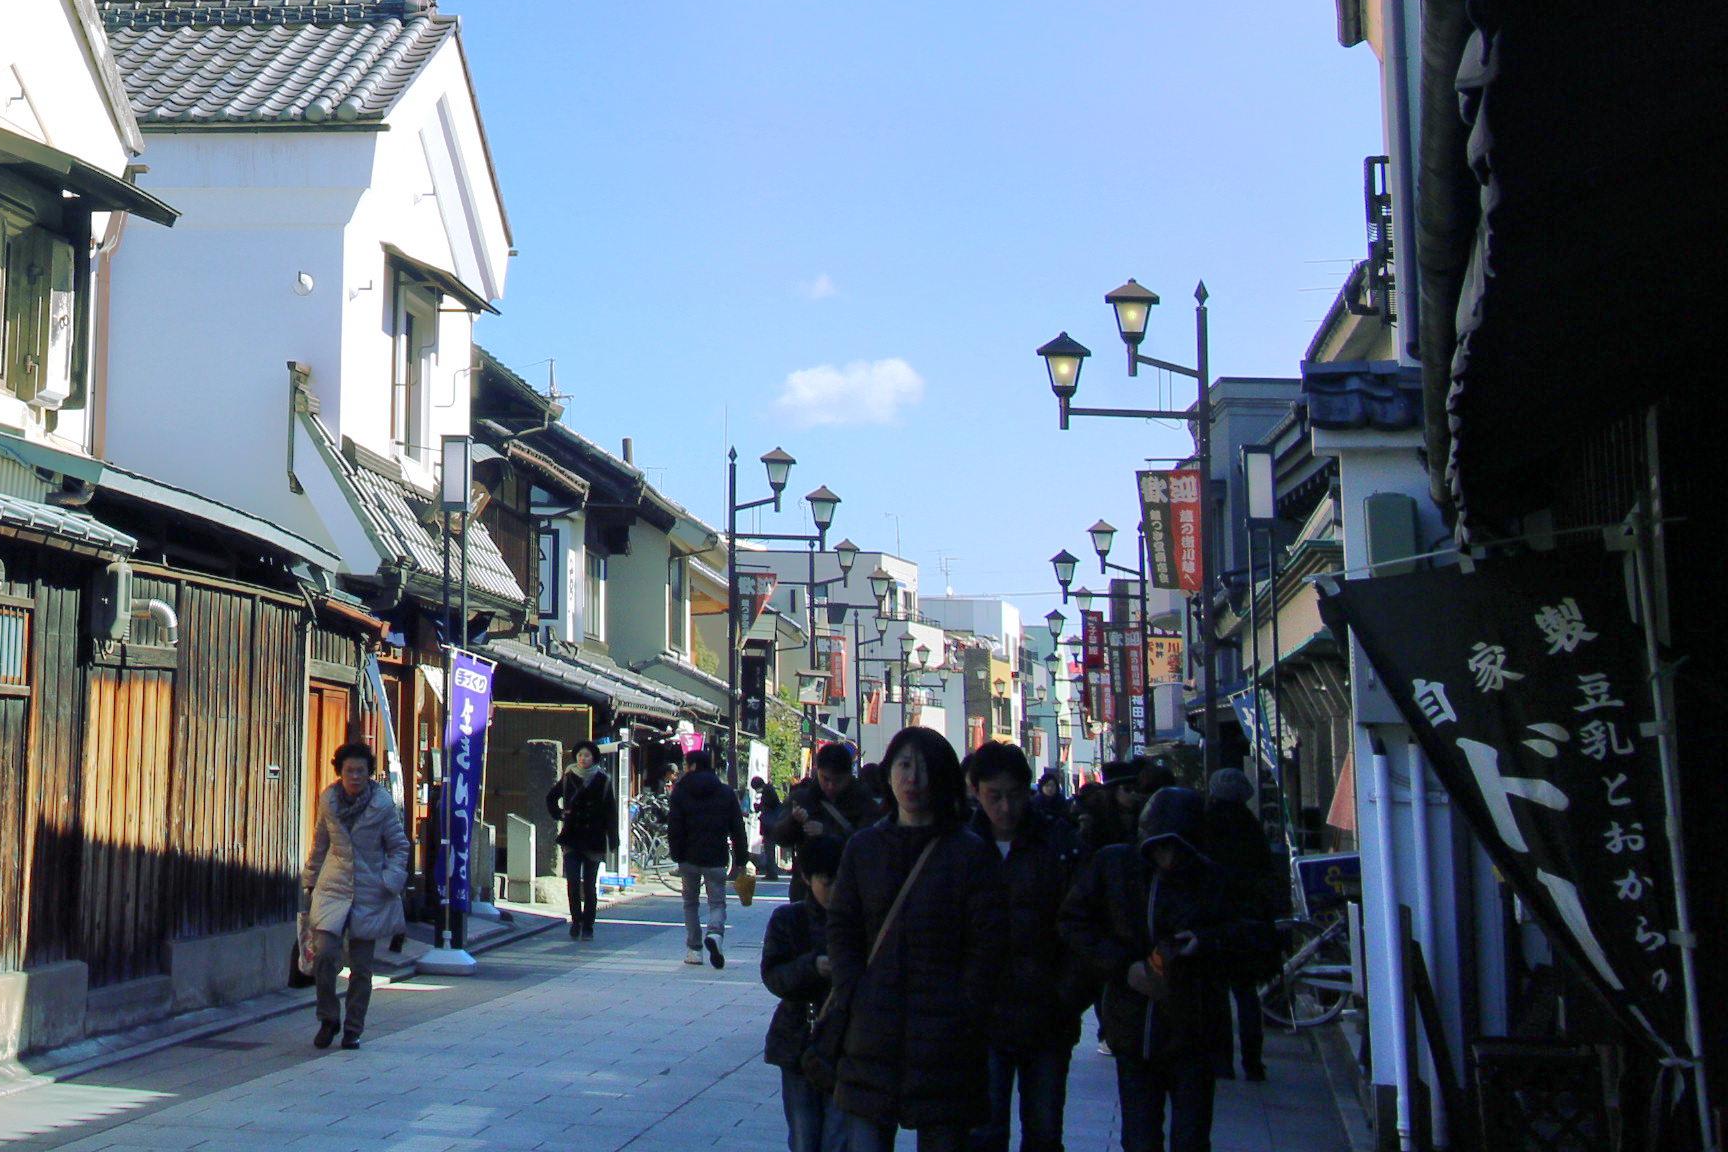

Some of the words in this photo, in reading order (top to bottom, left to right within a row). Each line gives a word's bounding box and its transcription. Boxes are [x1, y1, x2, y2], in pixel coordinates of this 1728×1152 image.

[456, 669, 486, 691] 手づくり
[1412, 598, 1600, 729] 自家製
